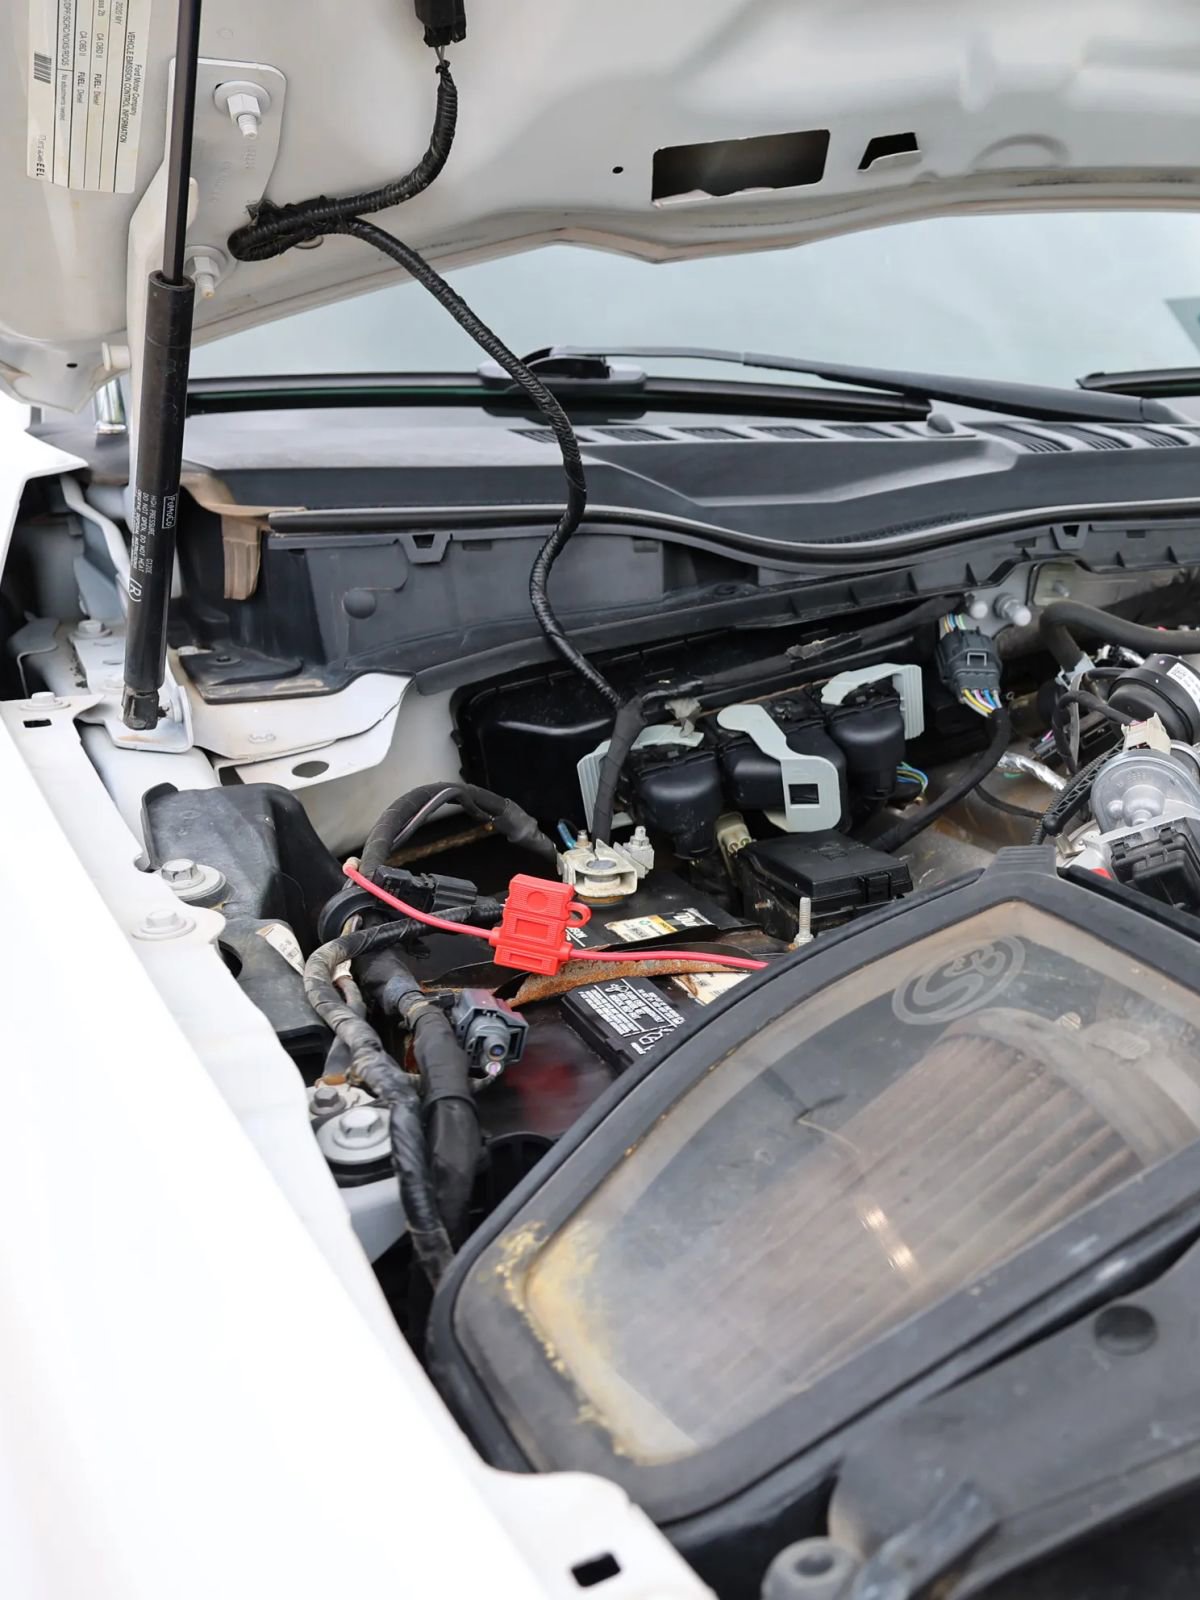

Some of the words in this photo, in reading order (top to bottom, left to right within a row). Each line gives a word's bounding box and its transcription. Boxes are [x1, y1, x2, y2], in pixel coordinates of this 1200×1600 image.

[126, 32, 135, 55] VEHICLE
[141, 502, 149, 516] NOT
[138, 544, 146, 557] NOT
